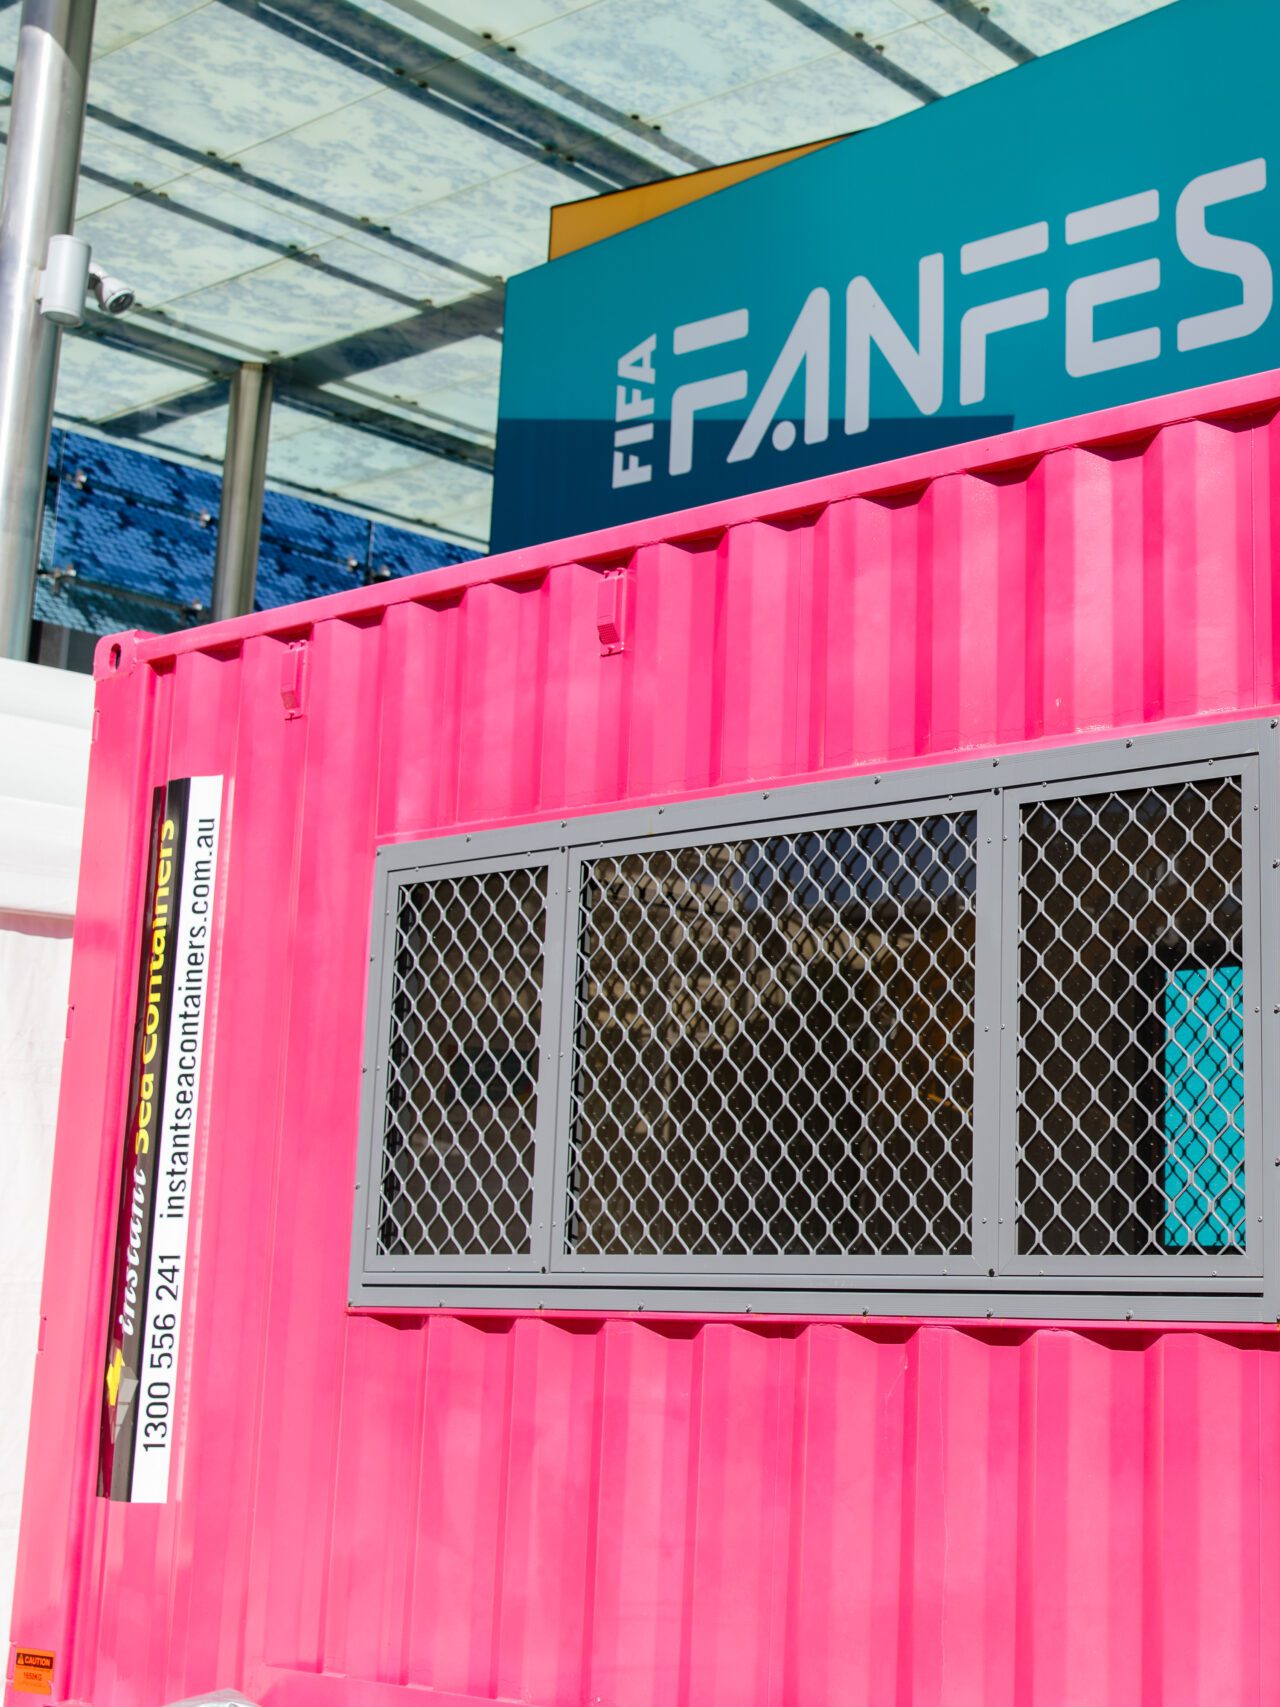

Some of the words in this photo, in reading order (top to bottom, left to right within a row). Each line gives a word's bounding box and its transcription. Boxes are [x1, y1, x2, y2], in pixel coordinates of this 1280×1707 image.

[612, 334, 656, 489] FIFA
[142, 819, 175, 1064] Containers
[159, 817, 216, 1219] instantseacontainers.com.au
[156, 1255, 182, 1301] 241
[150, 1313, 176, 1369] 556
[142, 1382, 171, 1450] 1300
[24, 1656, 51, 1667] CAUTION
